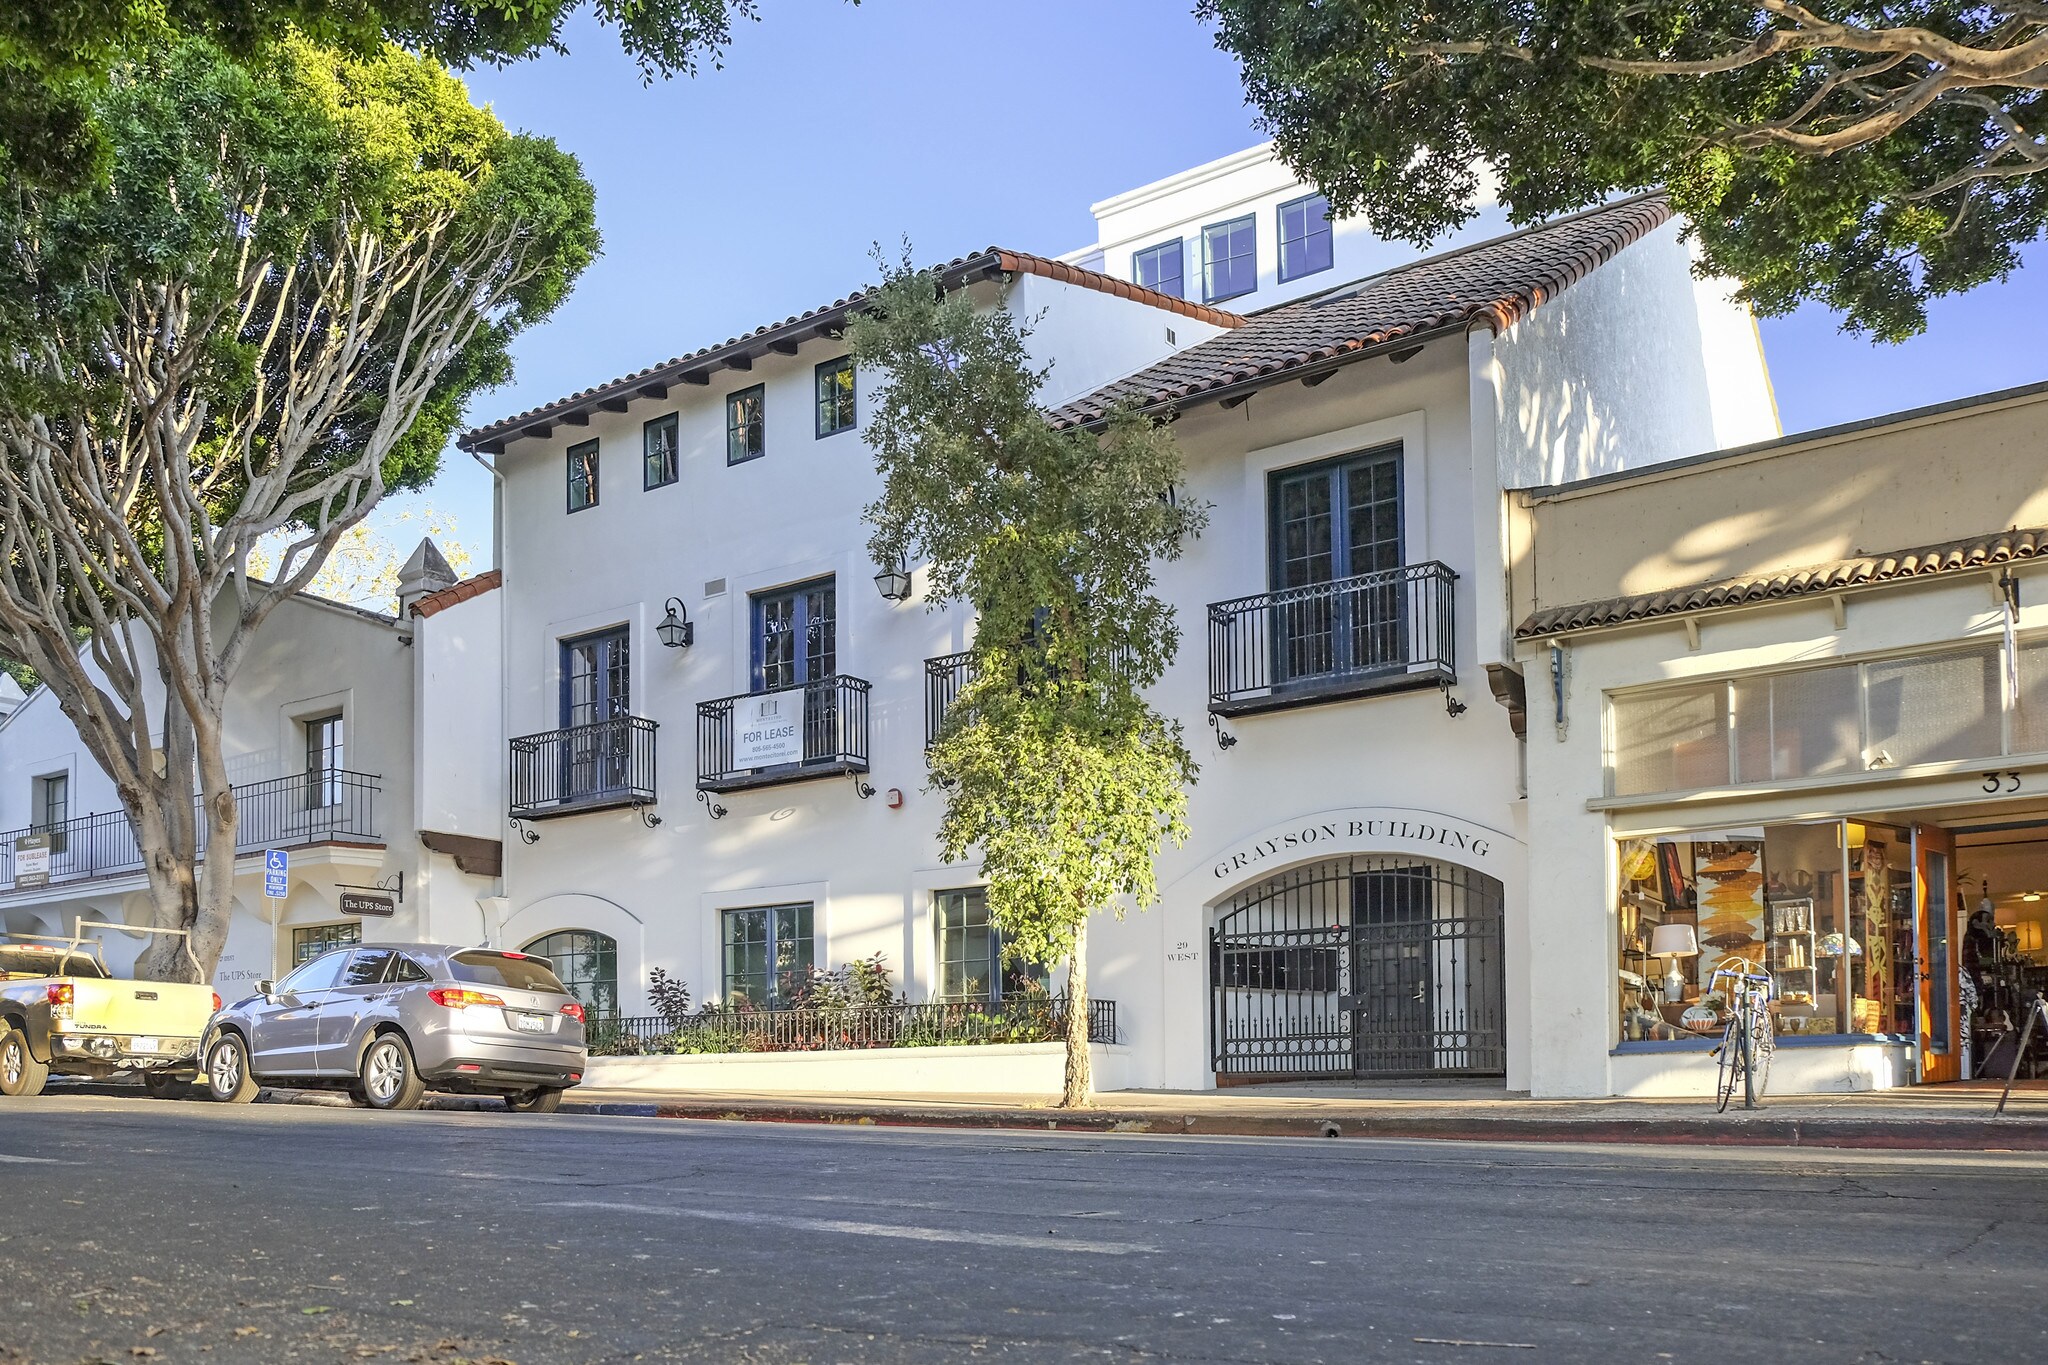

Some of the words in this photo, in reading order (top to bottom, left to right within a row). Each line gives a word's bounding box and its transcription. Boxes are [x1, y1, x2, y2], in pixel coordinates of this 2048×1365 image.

[743, 731, 762, 744] FOR
[764, 726, 794, 740] LEASE
[1982, 771, 2021, 794] 33
[1214, 823, 1337, 879] GRAYSON
[1347, 820, 1490, 857] BUILDING
[17, 853, 26, 862] FOR
[26, 851, 48, 861] SUBLEASE
[266, 868, 287, 878] PARKING
[270, 875, 283, 884] ONLY
[344, 899, 358, 908] The
[359, 900, 374, 910] UPS
[374, 902, 393, 912] Store
[1177, 941, 1188, 950] 29
[1167, 952, 1199, 961] WEST
[219, 971, 230, 981] The
[231, 970, 245, 981] UPS
[246, 969, 262, 980] Store
